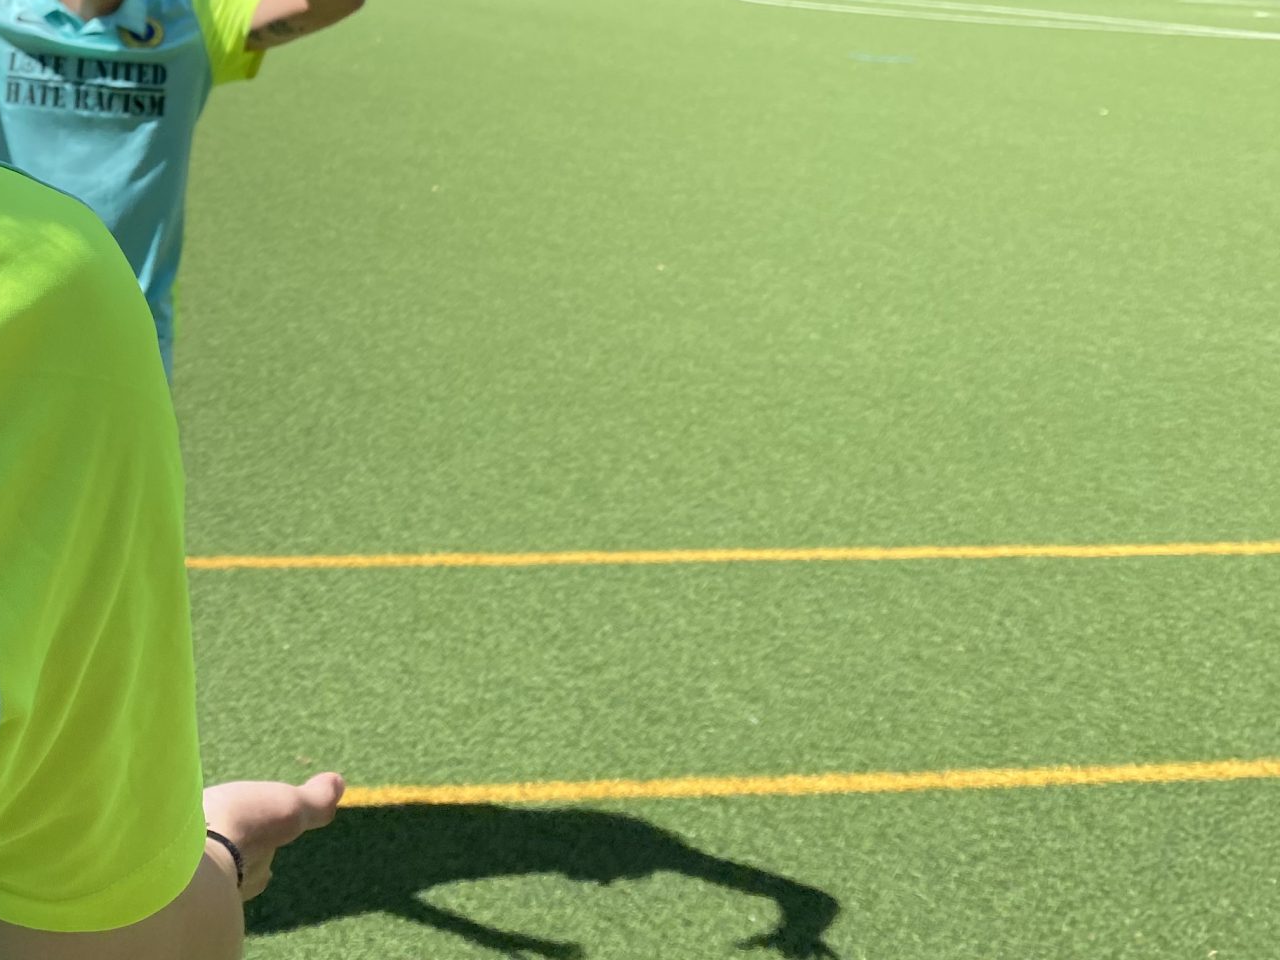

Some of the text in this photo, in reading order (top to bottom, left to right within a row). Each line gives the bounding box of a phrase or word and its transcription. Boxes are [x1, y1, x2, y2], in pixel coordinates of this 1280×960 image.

[76, 58, 167, 85] UNITED
[6, 81, 165, 116] HATE RACISM
